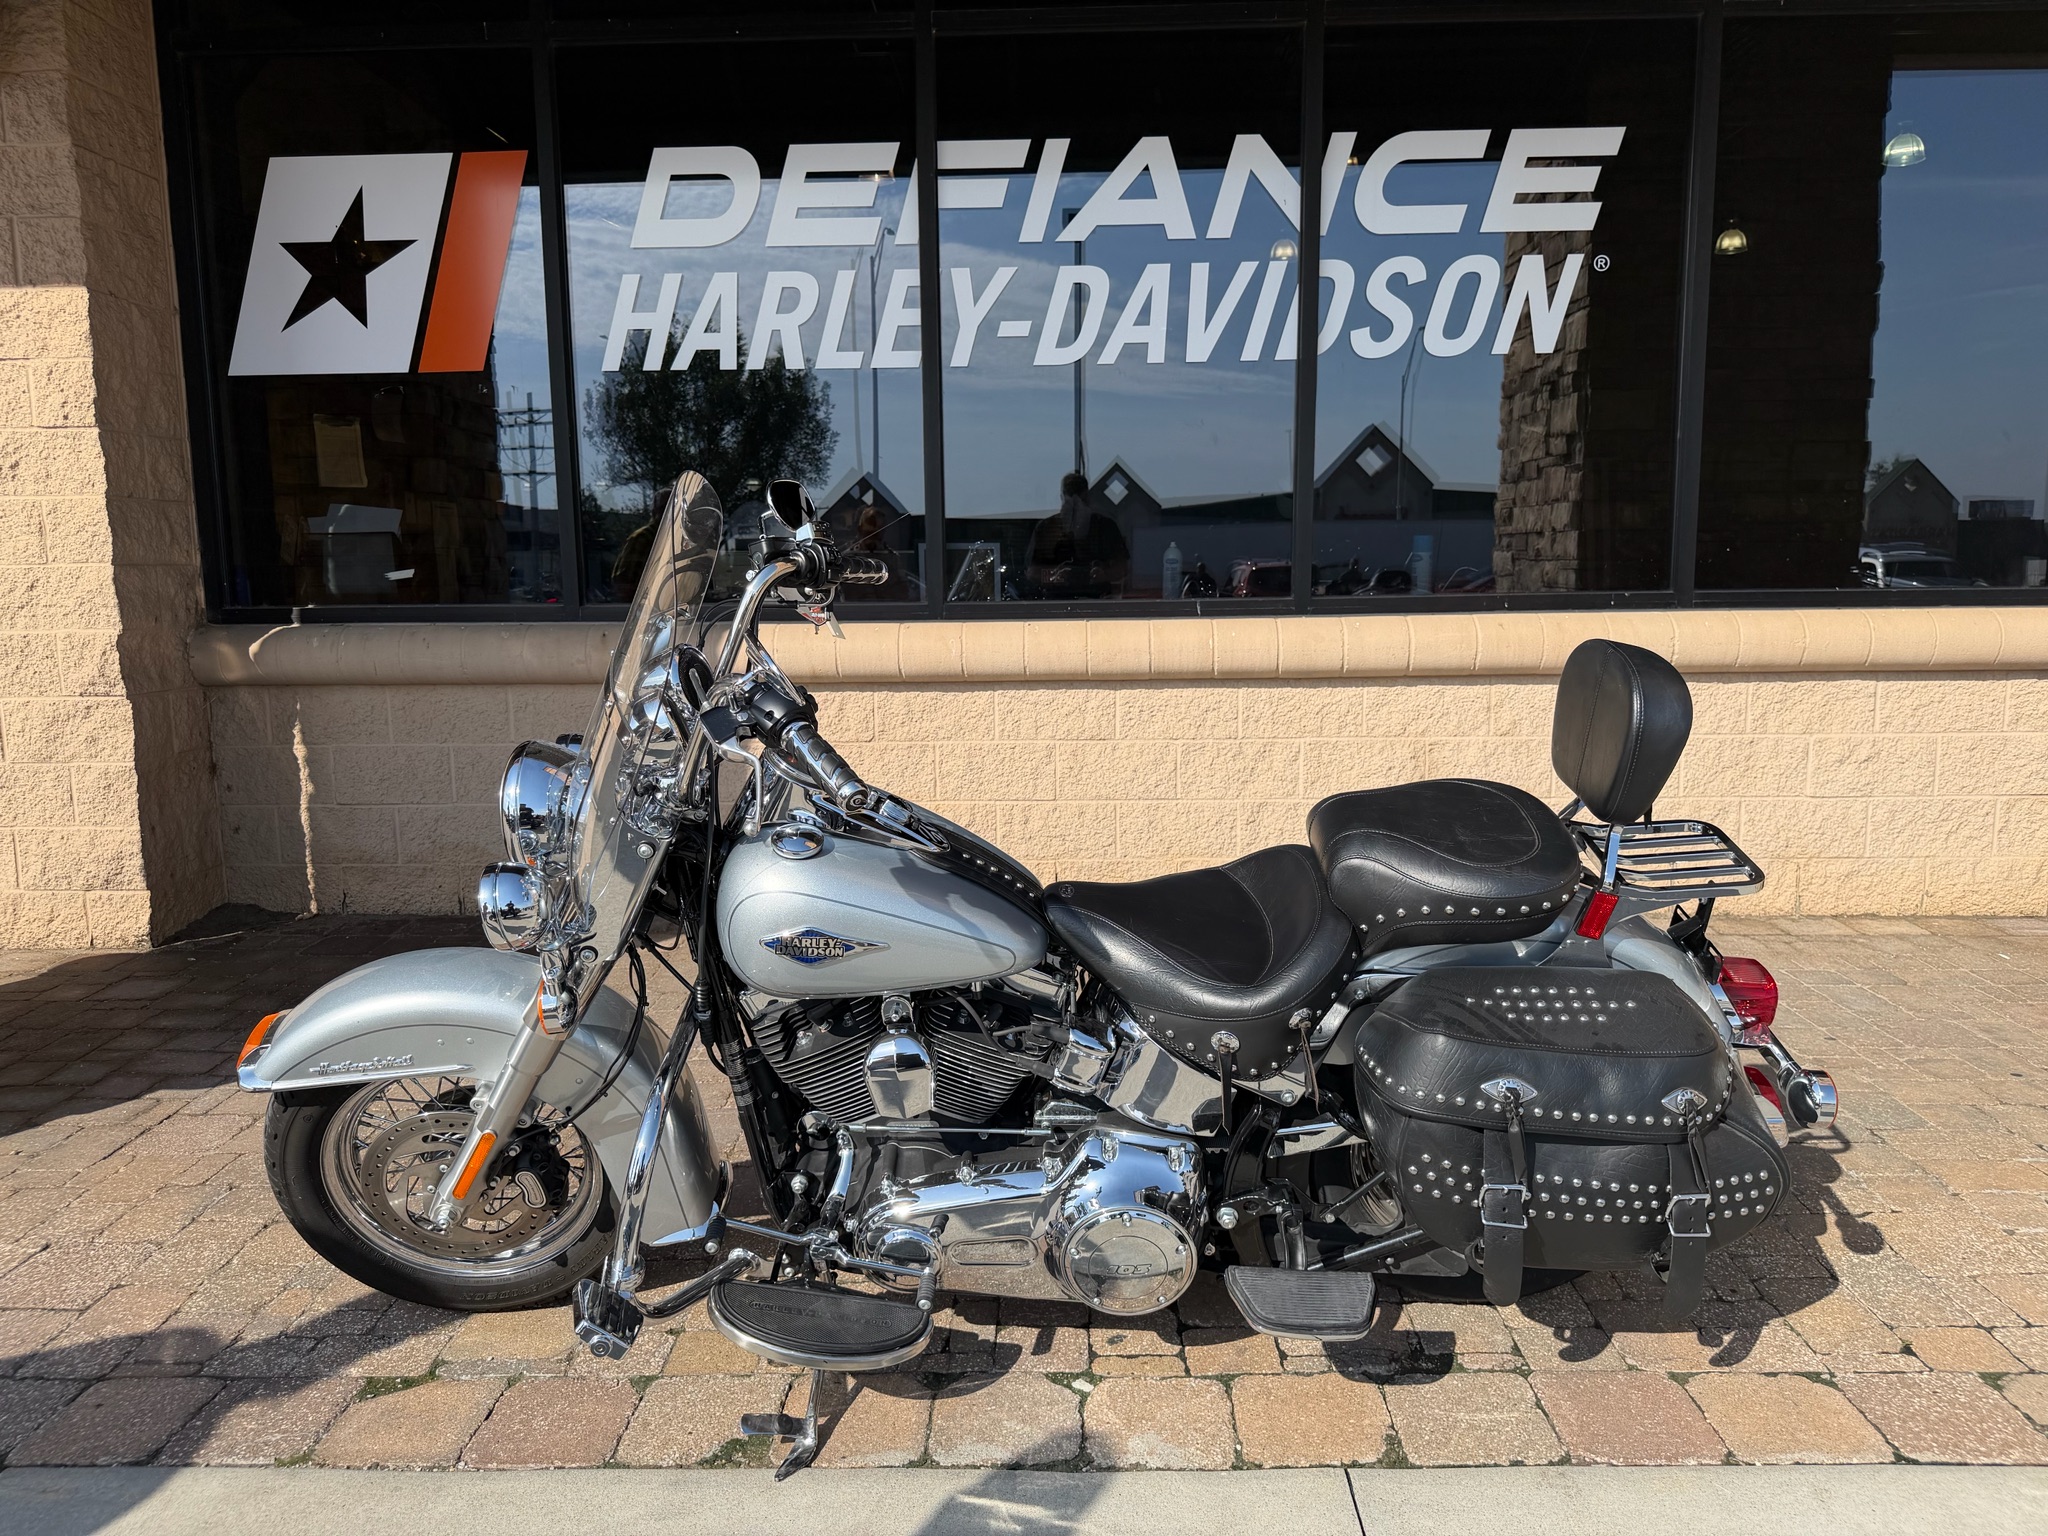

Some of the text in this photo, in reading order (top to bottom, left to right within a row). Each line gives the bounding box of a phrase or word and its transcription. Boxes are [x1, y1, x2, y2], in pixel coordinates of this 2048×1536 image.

[630, 127, 1626, 249] DEFIANCE
[601, 254, 1584, 372] HARLEY-DAVIDSON
[775, 946, 844, 958] DAVIDSON
[1107, 1264, 1152, 1275] 105
